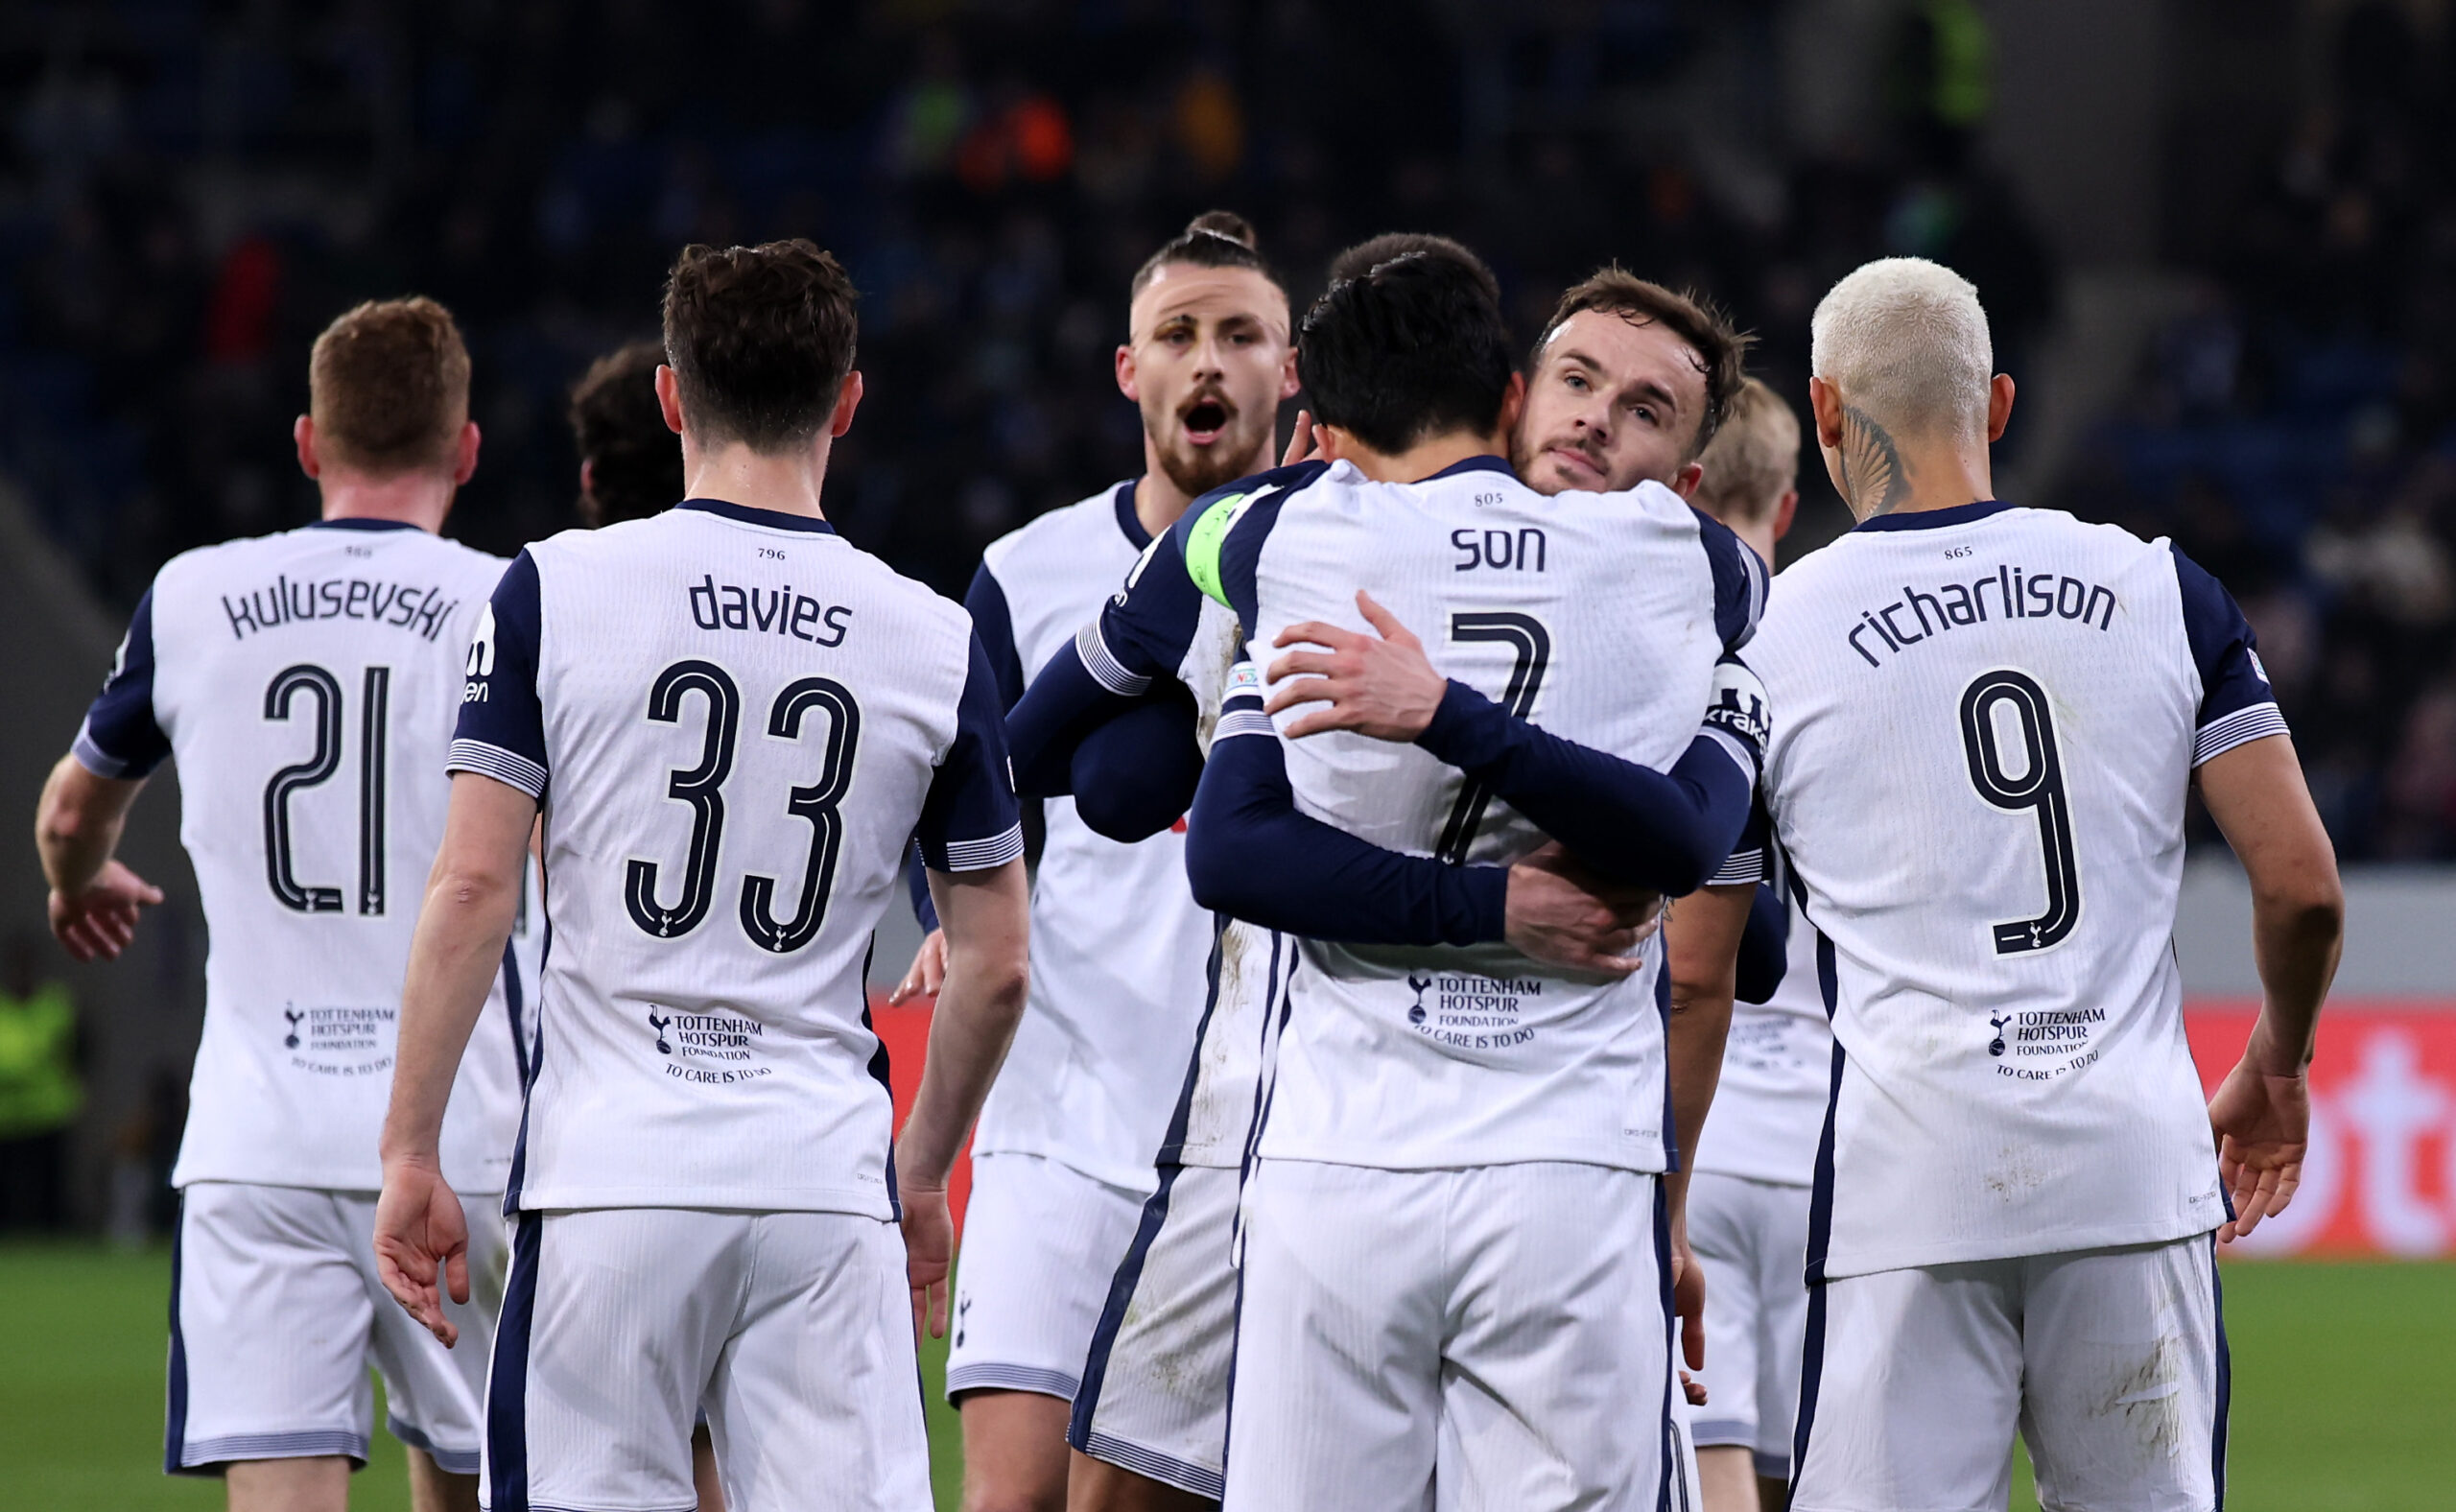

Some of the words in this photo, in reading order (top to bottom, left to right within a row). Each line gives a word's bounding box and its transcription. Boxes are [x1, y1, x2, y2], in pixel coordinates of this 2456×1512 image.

[1475, 493, 1503, 508] 805
[757, 548, 786, 561] 796
[1944, 546, 1973, 560] 865
[223, 575, 460, 643] kulusevski
[689, 574, 853, 649] davies
[1848, 564, 2116, 669] richarlison
[1434, 611, 1551, 867] 7
[263, 663, 390, 915] 21
[624, 658, 861, 954] 33
[1956, 668, 2082, 957] 9
[1438, 978, 1541, 996] TOTTENHAM
[1440, 995, 1519, 1012] HOTSPUR
[310, 1008, 395, 1023] TOTTENHAM
[1440, 1015, 1519, 1028] FOUNDATION
[2017, 1007, 2106, 1027] TOTTENHAM
[674, 1015, 763, 1037] TOTTENHAM
[2018, 1026, 2089, 1042] HOTSPUR
[679, 1031, 749, 1048] HOTSPUR
[1434, 1029, 1472, 1049] CARE
[1476, 1035, 1488, 1049] IS
[1493, 1033, 1511, 1049] TO
[1515, 1028, 1535, 1045] DO
[682, 1047, 750, 1061] FOUNDATION
[666, 1062, 683, 1077] TO
[685, 1069, 720, 1084] CARE
[722, 1071, 735, 1084] IS
[737, 1070, 754, 1081] TO
[1996, 1064, 2014, 1077] TO
[2017, 1069, 2052, 1081] CARE
[2068, 1056, 2086, 1071] TO
[2087, 1050, 2099, 1066] DO
